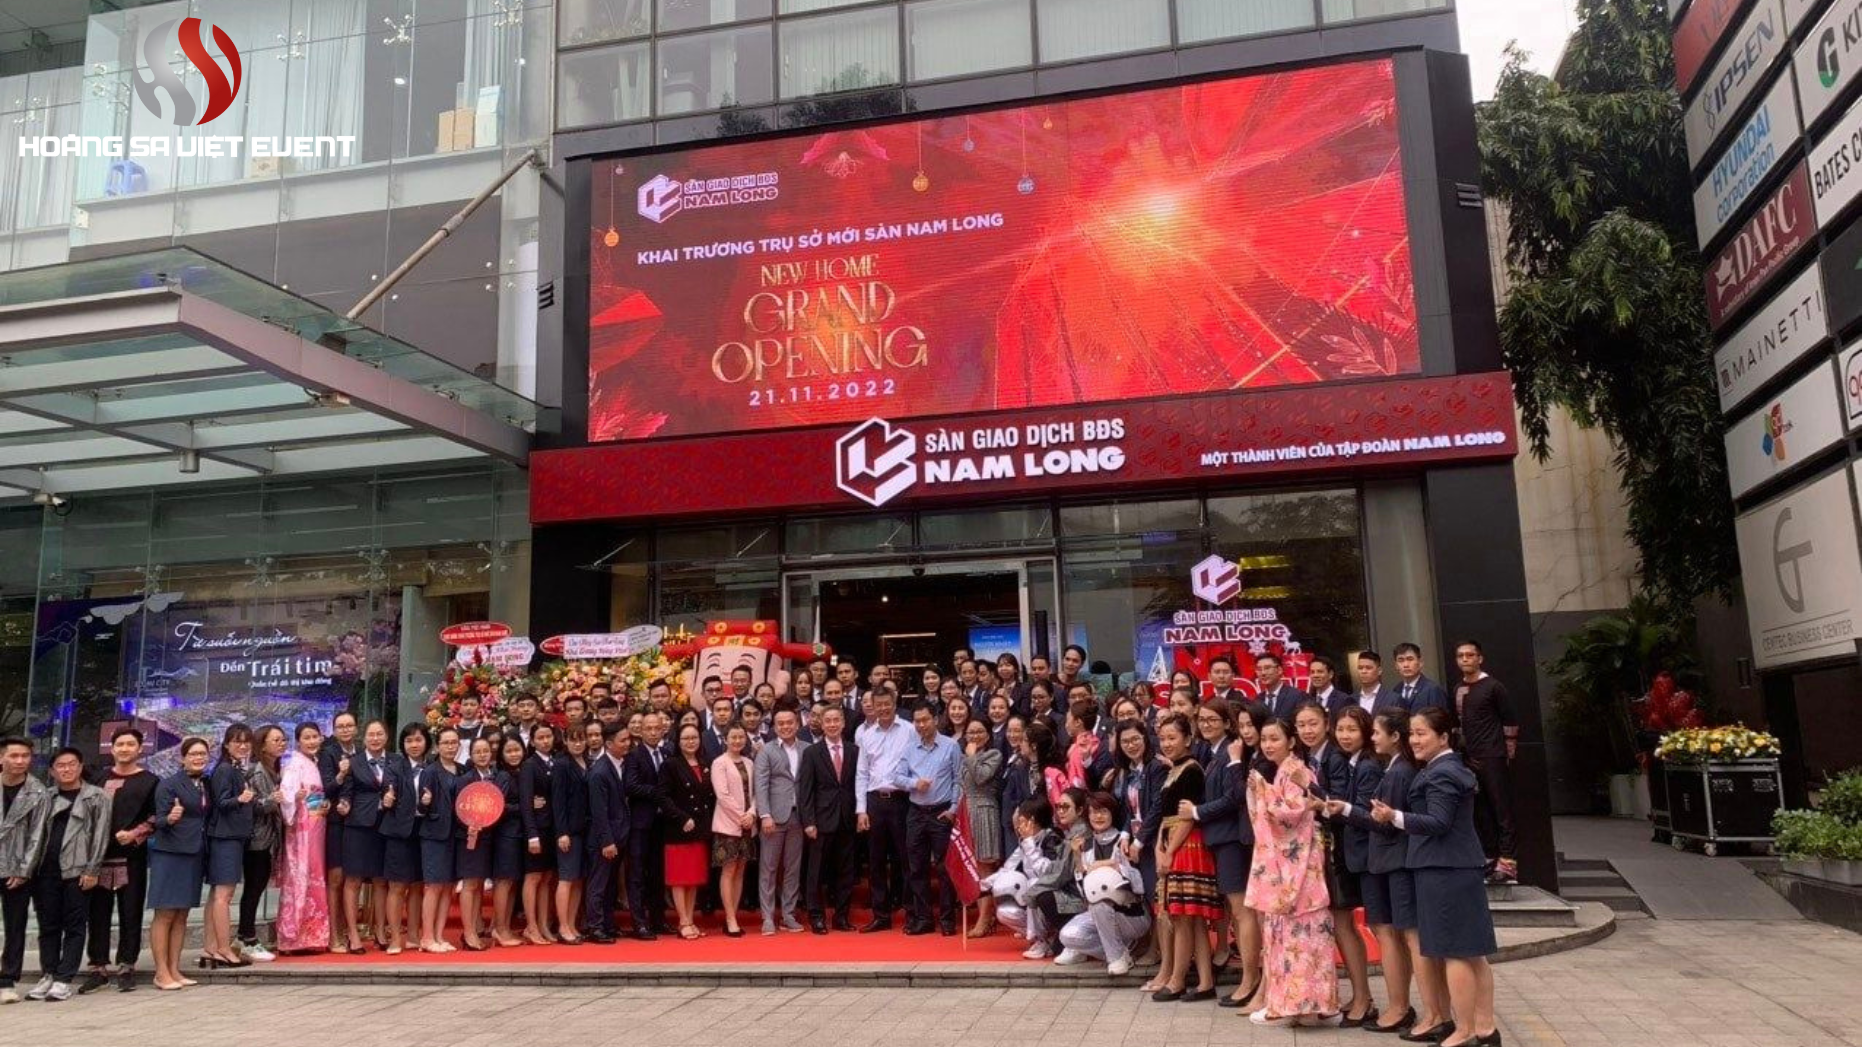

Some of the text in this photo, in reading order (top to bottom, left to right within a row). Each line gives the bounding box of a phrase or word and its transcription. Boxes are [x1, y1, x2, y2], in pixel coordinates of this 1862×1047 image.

[1713, 8, 1774, 114] IPSEN
[1713, 104, 1771, 198] HYUNDAI
[684, 179, 705, 194] SÀN
[706, 178, 730, 192] GIAO
[731, 175, 756, 190] DỊCH
[1814, 143, 1850, 200] BATES
[684, 187, 778, 209] NAM LONG
[637, 213, 1004, 265] KHAI TRƯƠNG TRỤ SỞ MỚI SÀN NAM LONG
[1734, 184, 1796, 282] DAFC
[761, 254, 879, 288] NEW HOME
[744, 281, 896, 333] GRAND
[1733, 290, 1821, 380] MAINETTI
[711, 326, 928, 383] OPENING
[749, 379, 895, 406] 21.11.2022
[925, 418, 1125, 453] SÀN GIAO DỊCH BĐS
[1201, 431, 1506, 467] MỘT THÀNH VIÊN CỦA TẬP ĐOÀN NAM LONG
[925, 446, 1125, 483] NAM LONG
[1164, 624, 1288, 643] NAM LONG
[1174, 610, 1195, 624] SÀN
[1198, 610, 1223, 623] GIAO
[1225, 610, 1251, 624] DỊCH
[1822, 619, 1854, 640] CENTER
[220, 661, 245, 674] Đến
